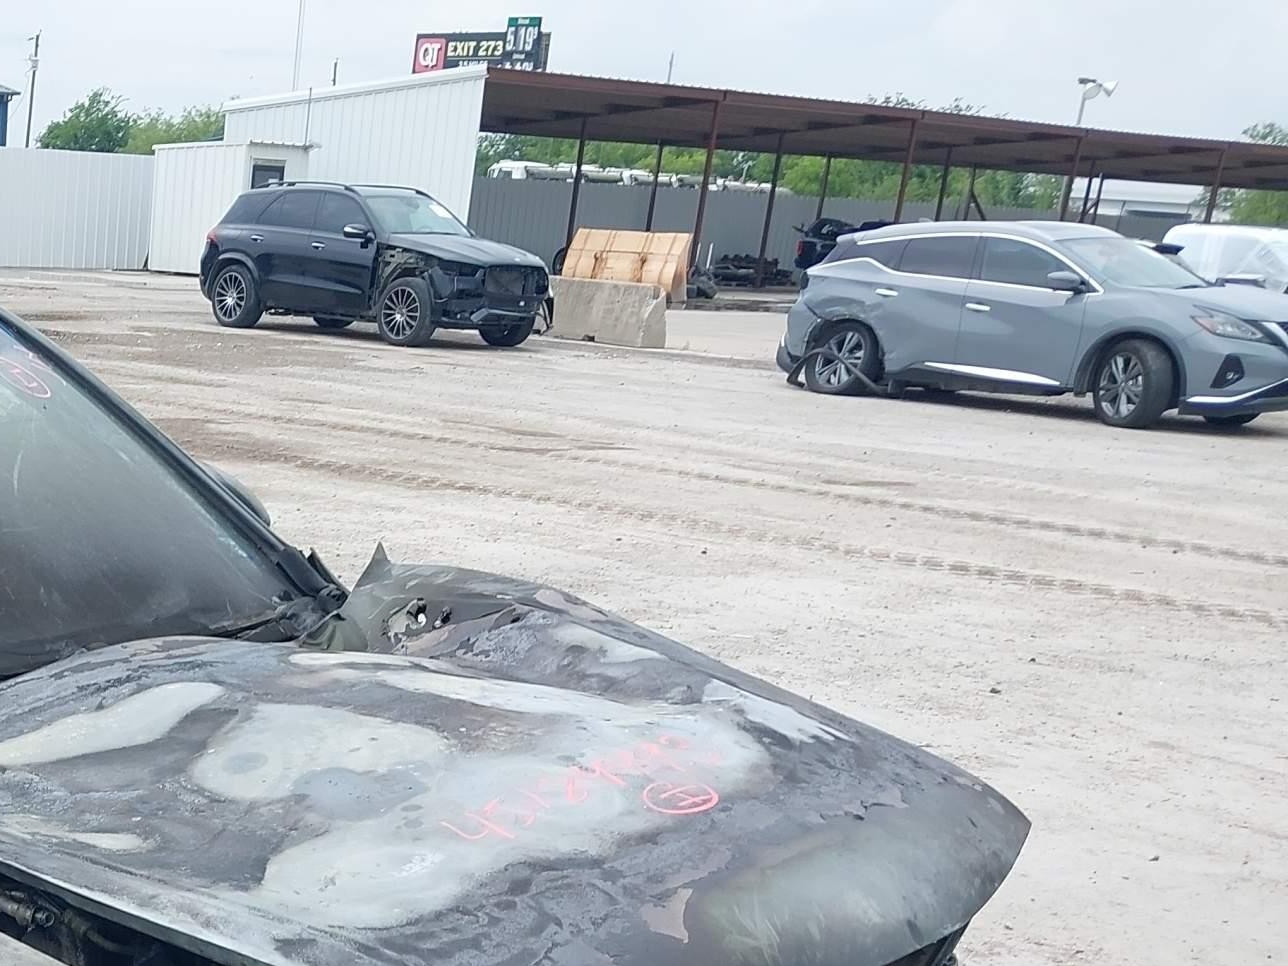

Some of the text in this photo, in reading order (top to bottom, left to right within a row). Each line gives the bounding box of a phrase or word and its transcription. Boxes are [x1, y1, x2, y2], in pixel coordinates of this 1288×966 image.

[419, 43, 441, 68] QT
[447, 41, 504, 56] EXIT 273
